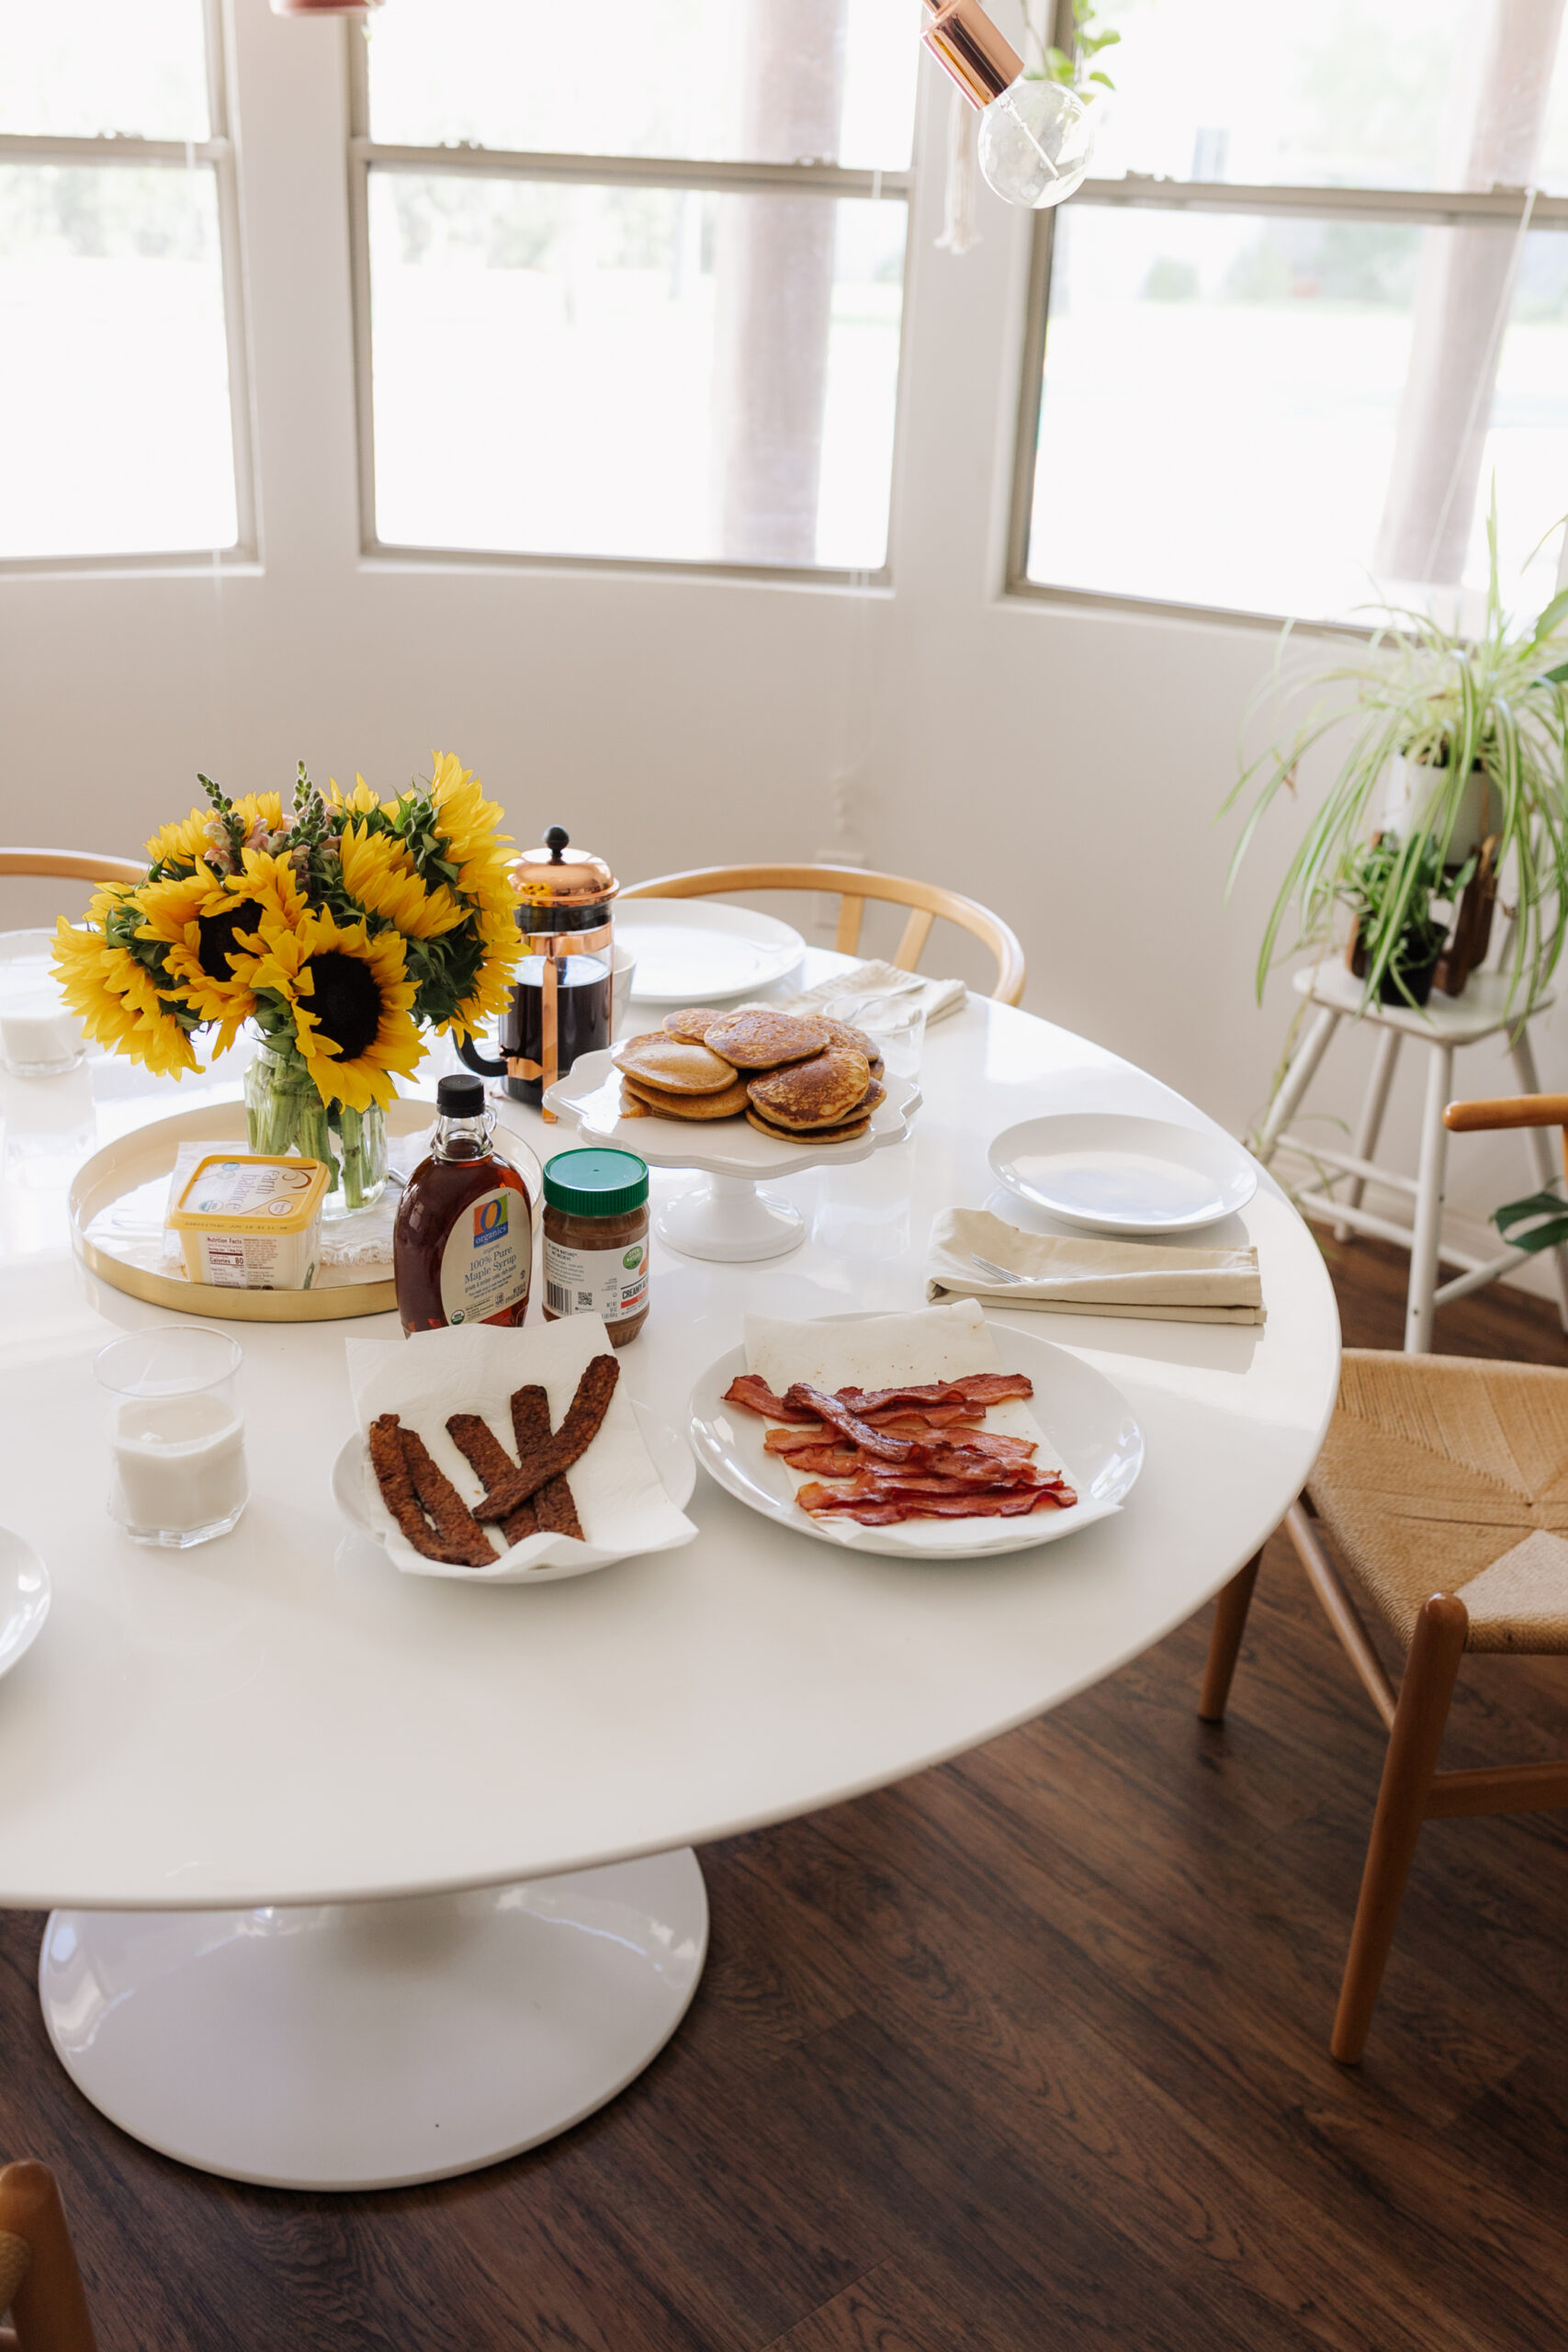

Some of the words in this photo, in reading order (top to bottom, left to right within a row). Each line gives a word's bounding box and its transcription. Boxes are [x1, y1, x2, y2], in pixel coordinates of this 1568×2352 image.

[255, 1170, 279, 1194] earth
[225, 1174, 260, 1210] balance
[475, 1226, 507, 1244] organics
[209, 1256, 231, 1264] Calories
[469, 1255, 493, 1272] 100%
[493, 1245, 513, 1261] Pure
[626, 1251, 642, 1263] NATURE
[628, 1248, 641, 1258] OPEN
[464, 1262, 491, 1284] Maple
[492, 1253, 516, 1272] Syrup
[622, 1284, 642, 1300] CREAMY
